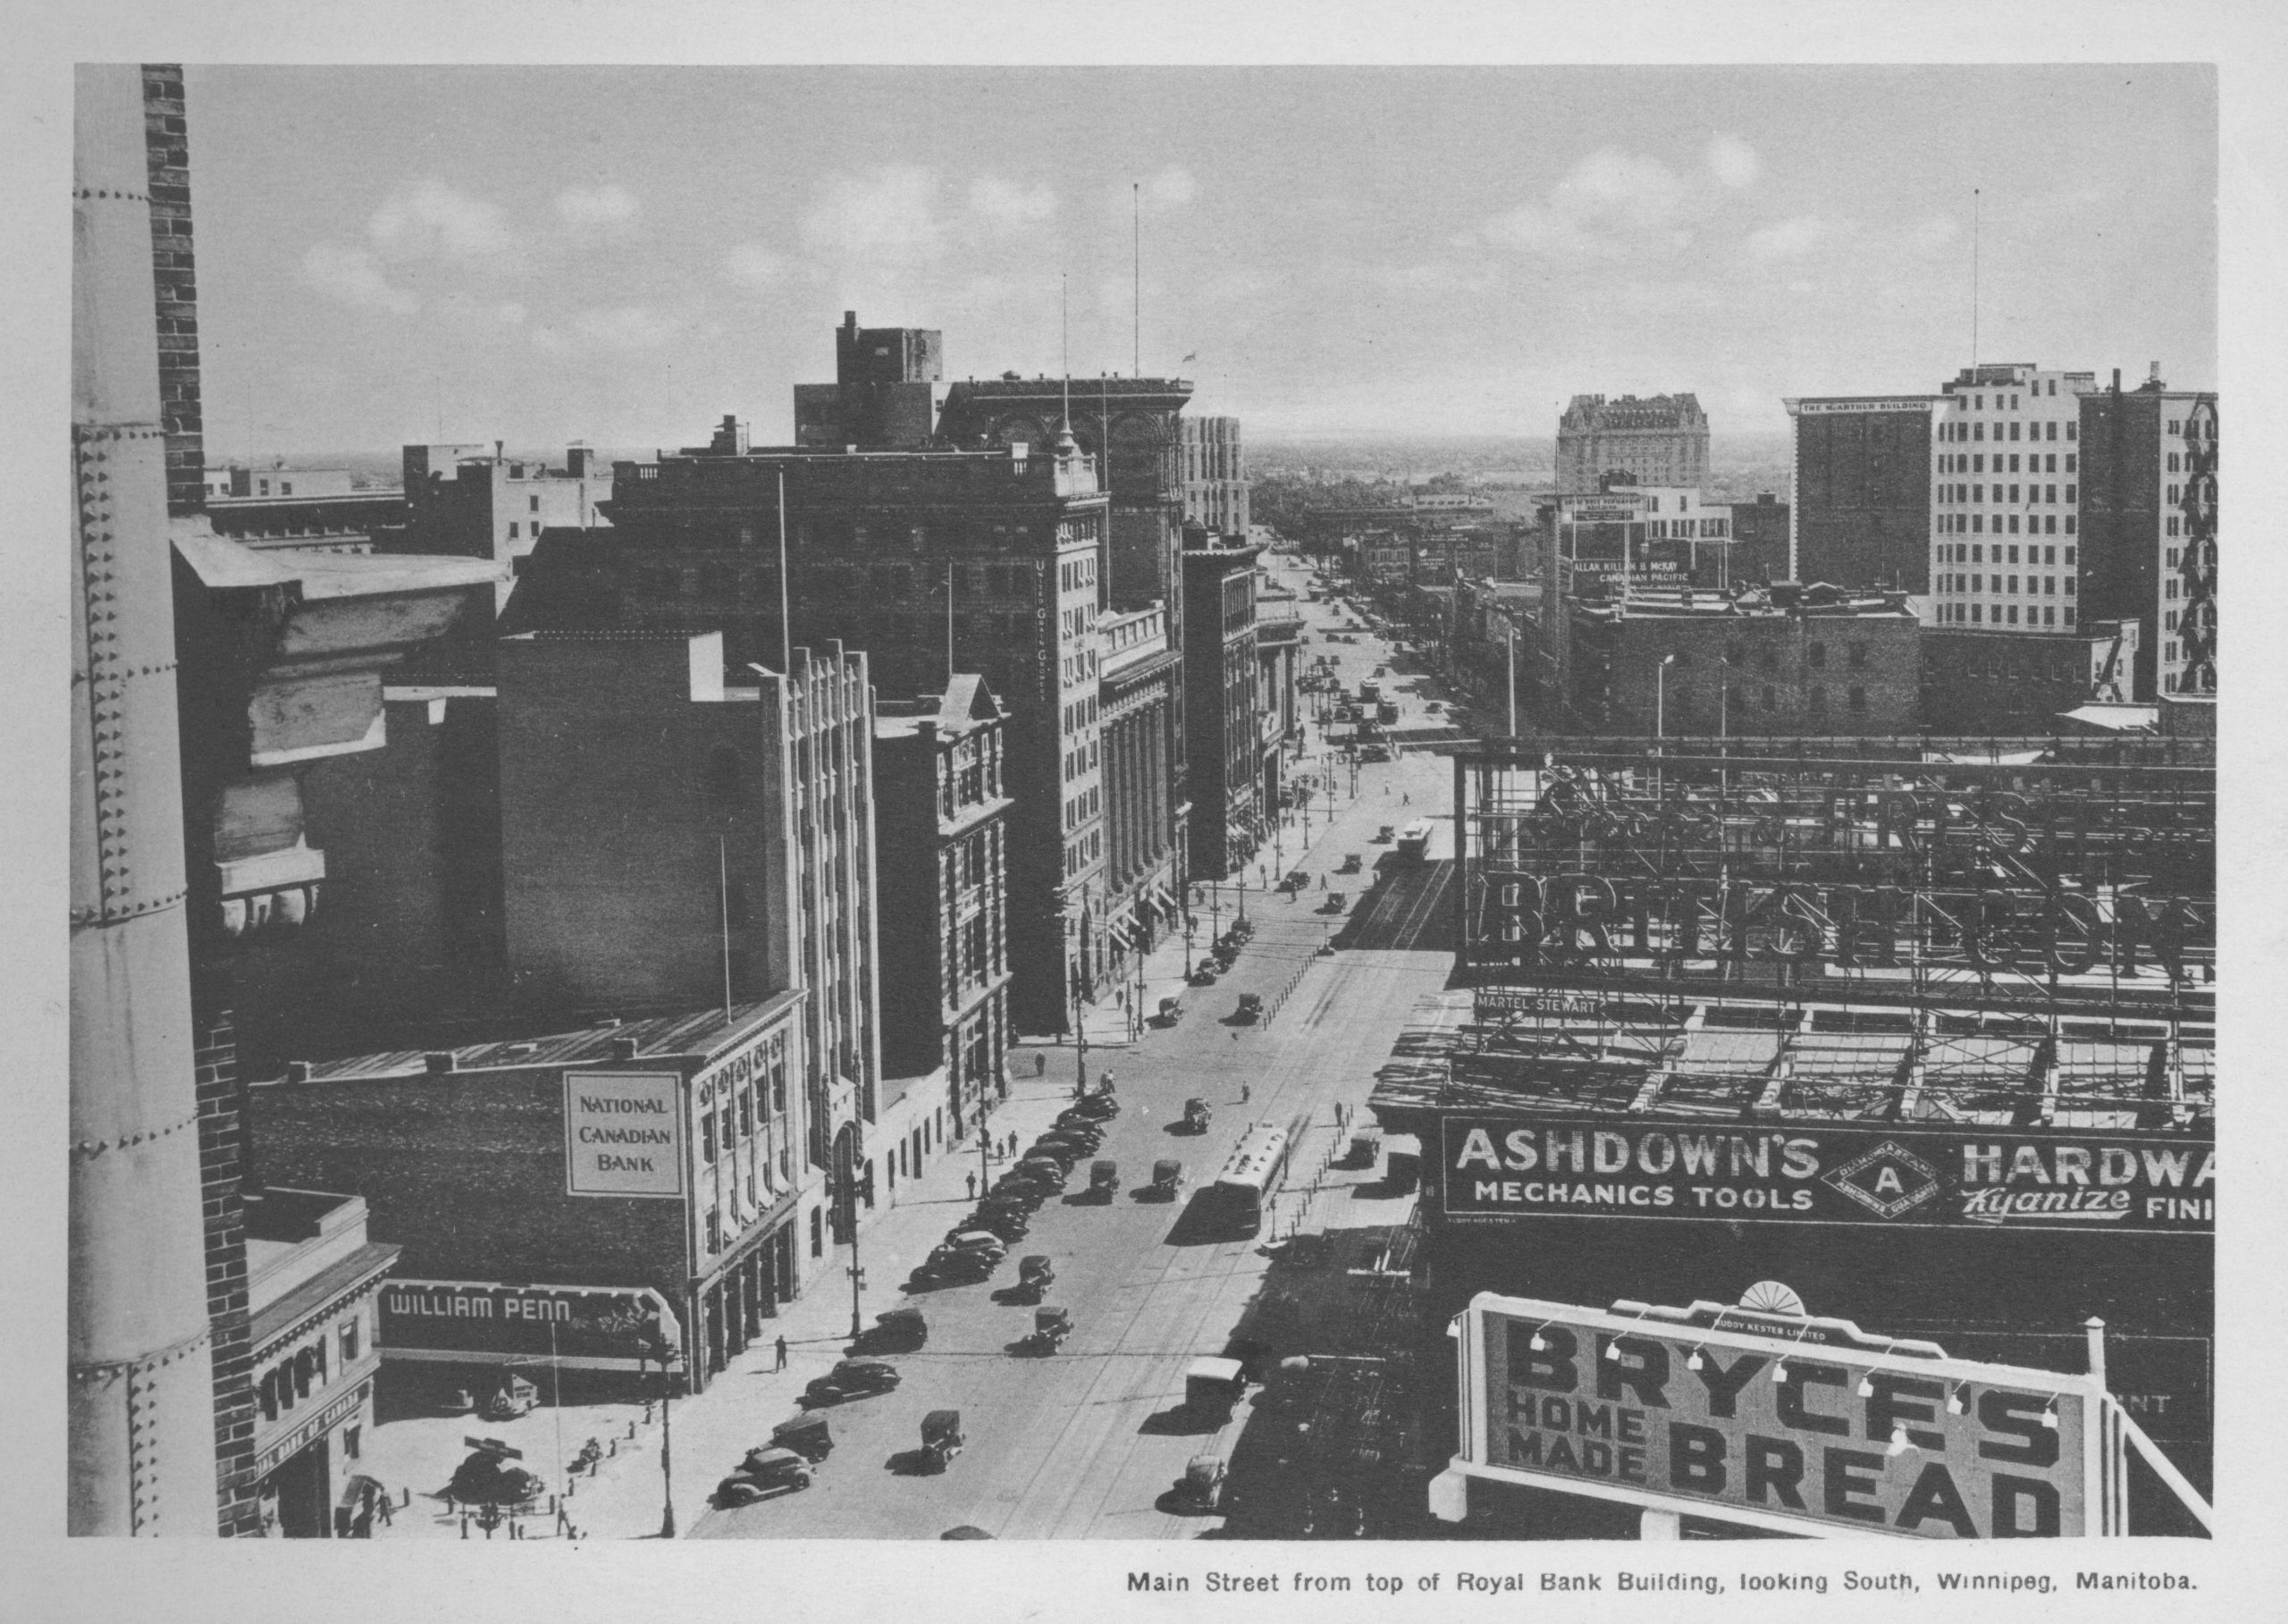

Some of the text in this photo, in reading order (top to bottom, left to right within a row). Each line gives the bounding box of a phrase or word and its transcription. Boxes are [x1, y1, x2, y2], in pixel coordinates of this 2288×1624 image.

[1804, 404, 1821, 412] THE
[1880, 402, 1927, 410] BUILDING
[1651, 573, 1689, 582] PACIFIC
[1037, 608, 1047, 646] GRAIN
[1536, 998, 1596, 1013] STEWART
[580, 1096, 669, 1115] NATIONAL
[579, 1126, 670, 1144] CANADIAN
[597, 1154, 654, 1172] BANK
[1456, 1128, 1820, 1179] ASHDOWN'S
[1874, 1166, 1905, 1193] A
[1476, 1181, 1813, 1211] MECHANICS TOOLS
[390, 1293, 570, 1322] WILLIAM PENN
[1747, 1323, 1784, 1335] KESTER
[1788, 1329, 1826, 1341] LIMITED
[1507, 1319, 2059, 1468] BRYCE'S
[1507, 1388, 1646, 1443] HOME
[1508, 1430, 1647, 1484] MADE
[1669, 1421, 2060, 1539] BREAD
